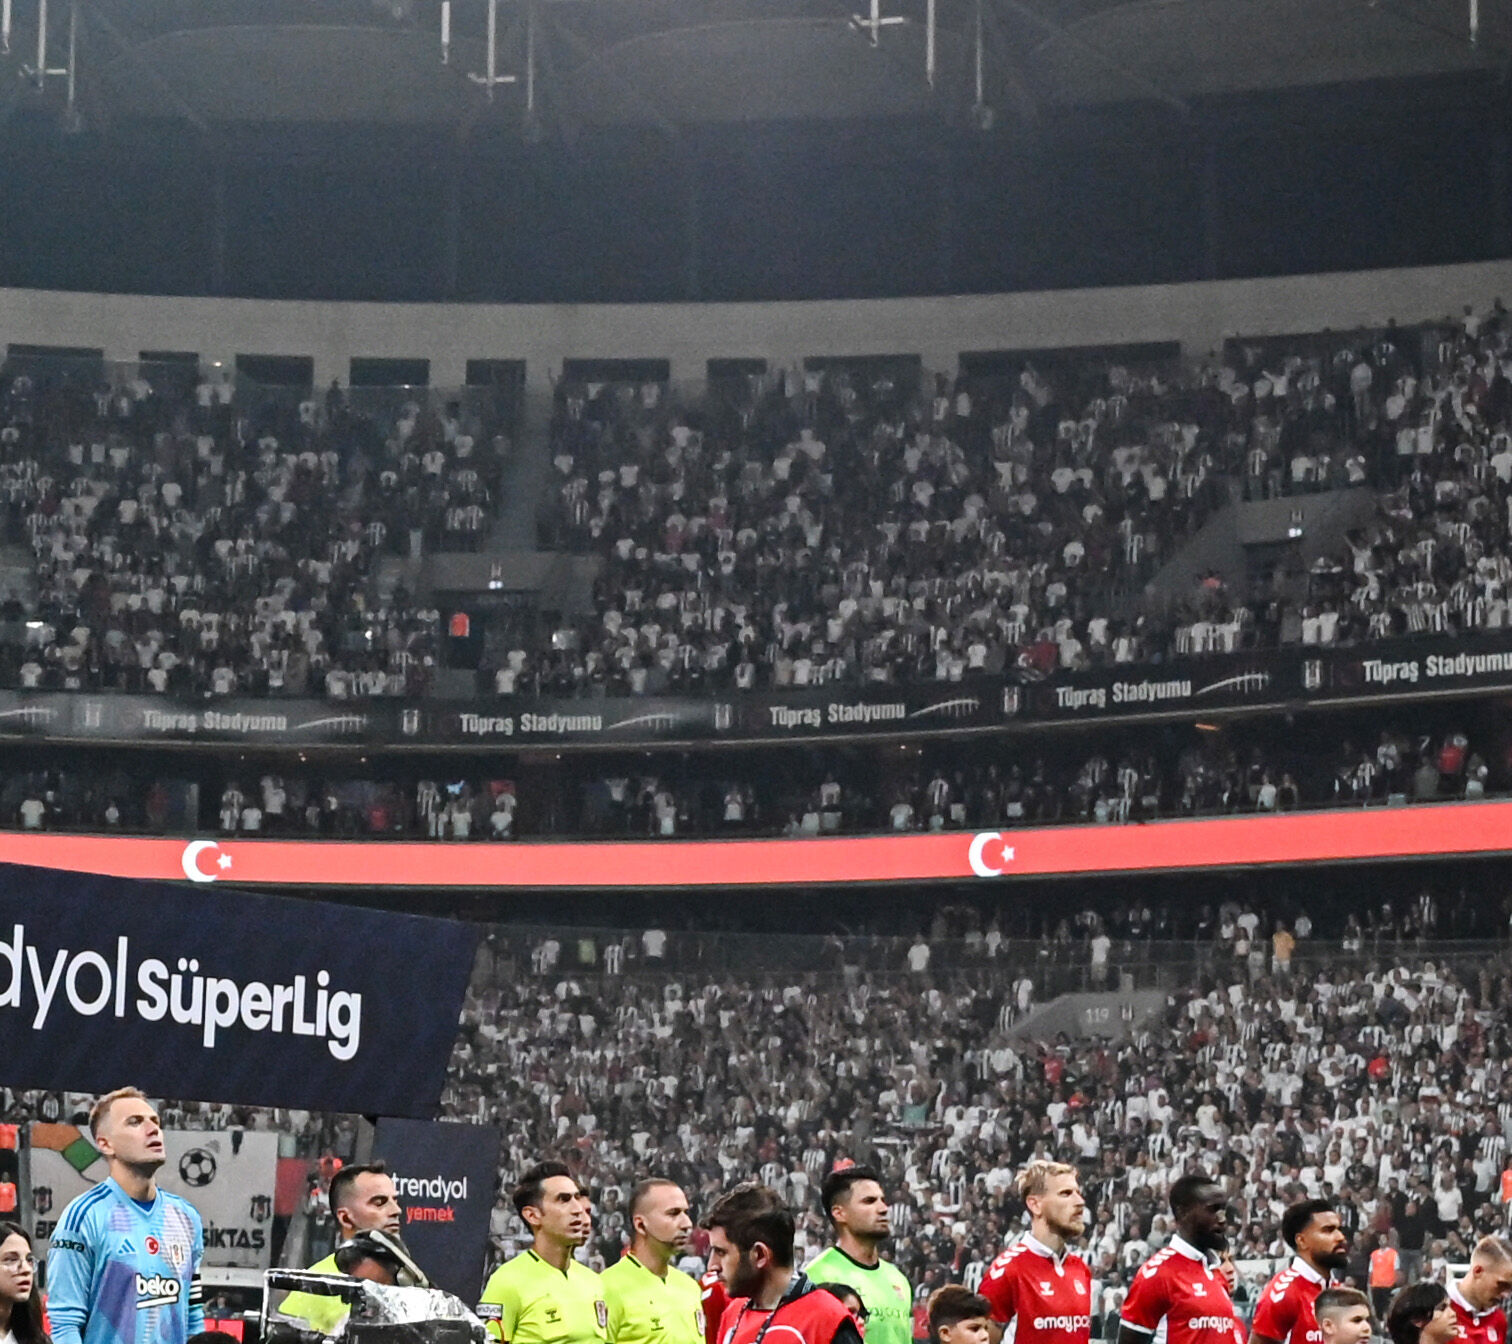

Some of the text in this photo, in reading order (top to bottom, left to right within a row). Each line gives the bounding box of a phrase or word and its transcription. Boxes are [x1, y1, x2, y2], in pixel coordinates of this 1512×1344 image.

[1362, 659, 1419, 685] Tüpraş
[1057, 679, 1191, 710] Tüpraş Stadyumu
[460, 713, 602, 736] Tüpraş Stadyumu
[770, 703, 905, 728] Tüpraş Stadyumu
[391, 1173, 467, 1202] trendyol
[406, 1205, 454, 1224] yemek
[135, 1273, 182, 1299] beko
